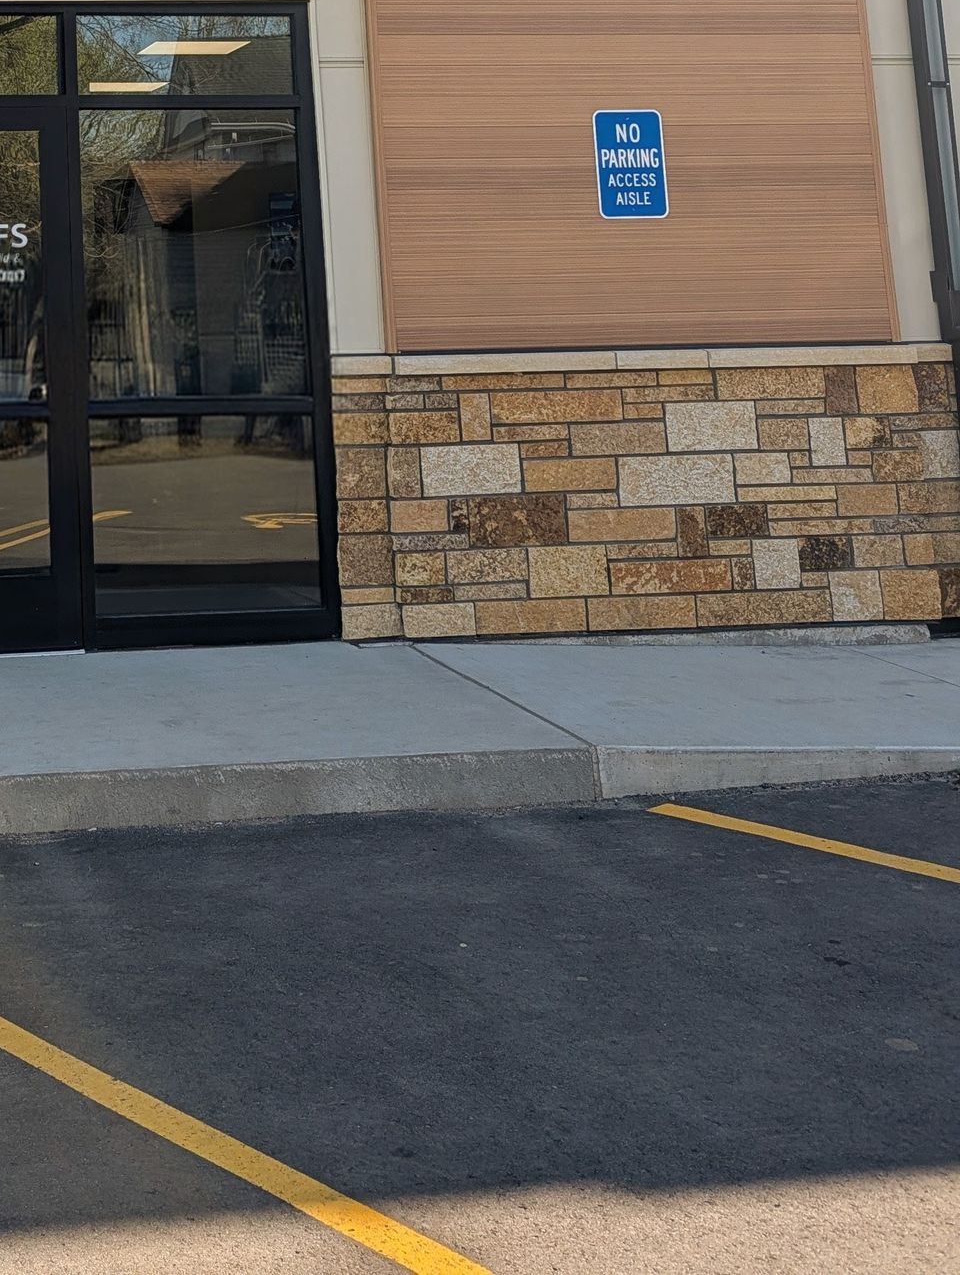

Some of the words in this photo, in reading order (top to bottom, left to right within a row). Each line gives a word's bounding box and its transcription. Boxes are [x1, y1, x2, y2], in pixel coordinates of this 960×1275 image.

[615, 123, 640, 143] NO
[601, 148, 660, 169] PARKING
[608, 173, 657, 187] ACCESS
[616, 192, 652, 205] AISLE
